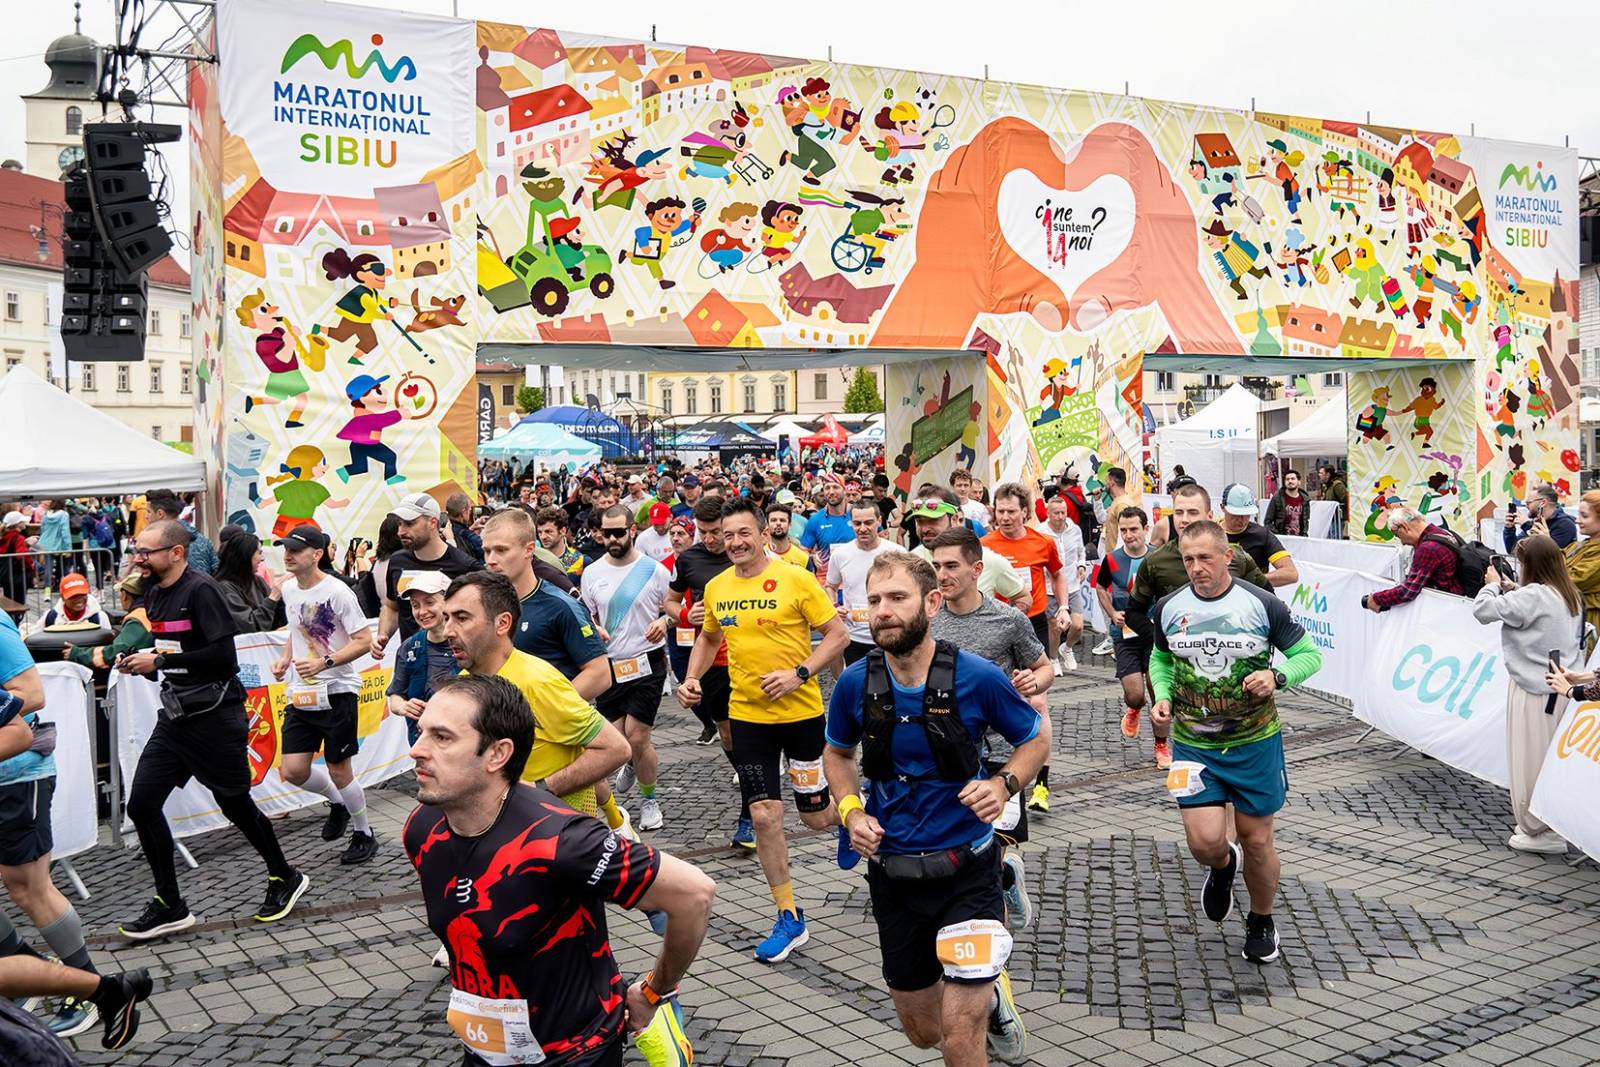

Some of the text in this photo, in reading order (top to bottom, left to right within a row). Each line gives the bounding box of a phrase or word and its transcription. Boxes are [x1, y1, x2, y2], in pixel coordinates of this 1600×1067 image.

[273, 81, 431, 116] MARATONUL
[274, 105, 431, 136] INTERNAȚIONAL
[299, 133, 397, 168] SIBIU
[1495, 195, 1563, 214] MARATONUL
[1053, 222, 1091, 233] suntem
[1505, 227, 1548, 248] SIBIU
[716, 599, 777, 612] INVICTUS
[1177, 637, 1243, 649] CUGIRACE
[361, 676, 374, 689] TĂ
[374, 675, 385, 688] DE
[296, 694, 312, 705] 103
[796, 773, 808, 783] 13
[586, 852, 614, 886] LIBRA
[953, 941, 976, 960] 50
[465, 1021, 489, 1044] 66
